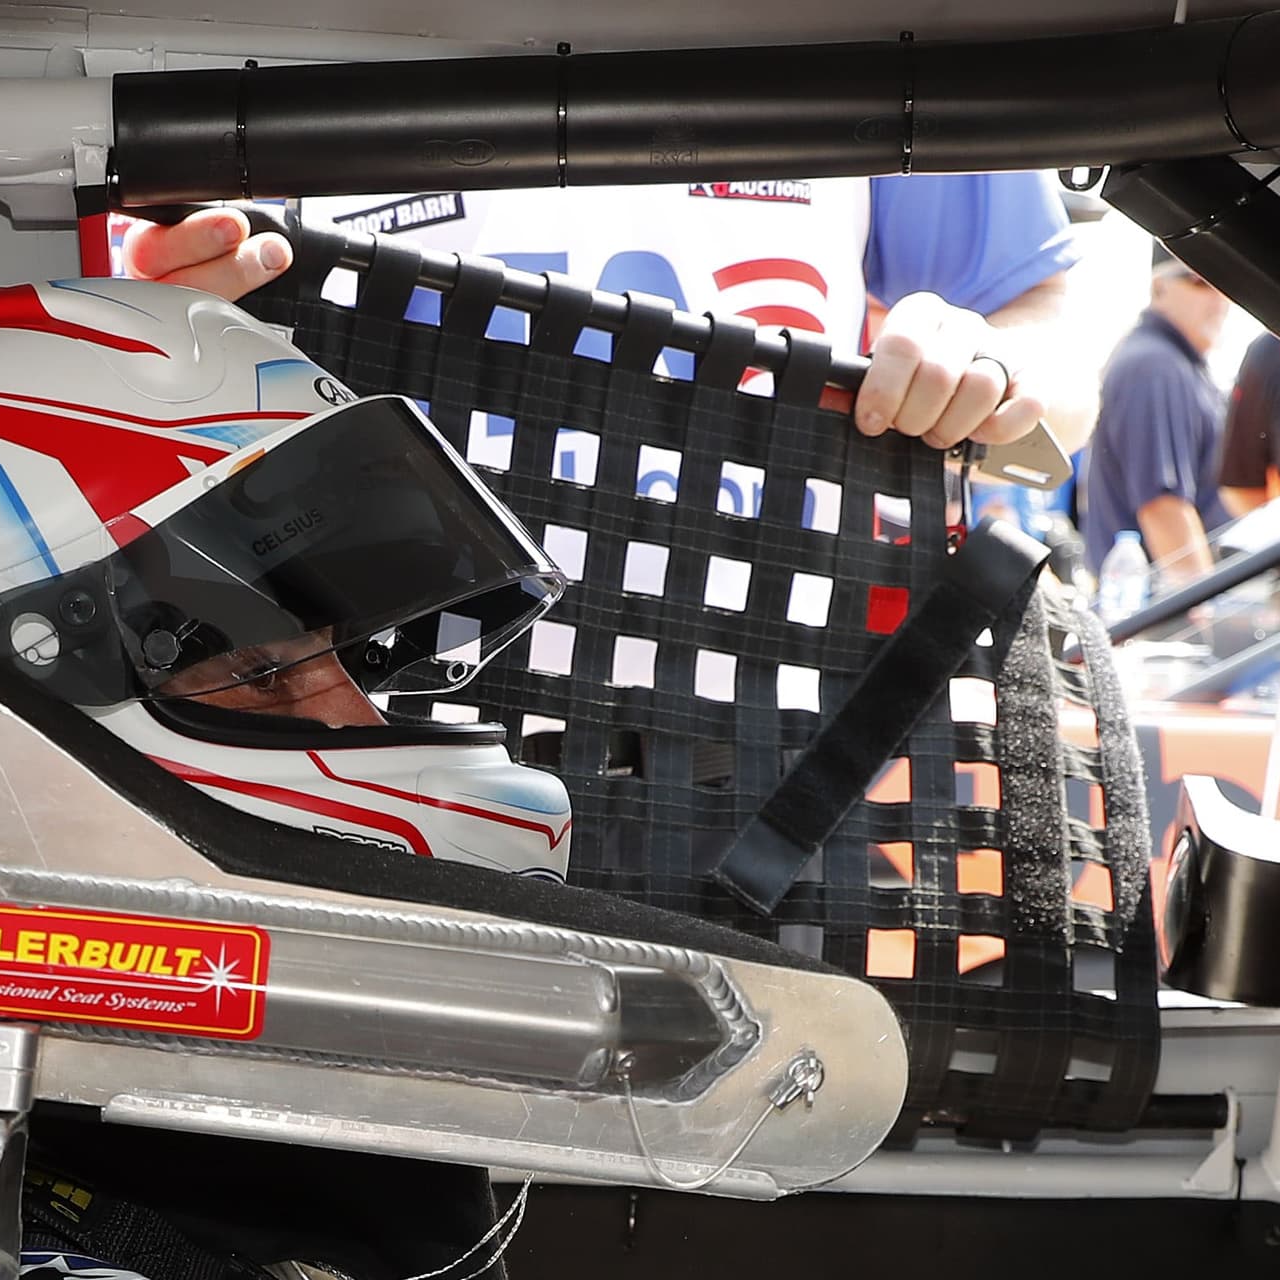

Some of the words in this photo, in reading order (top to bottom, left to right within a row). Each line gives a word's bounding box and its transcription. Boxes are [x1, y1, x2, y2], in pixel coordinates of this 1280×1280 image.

[396, 194, 457, 227] BARN
[252, 507, 324, 557] CELSIUS
[57, 988, 105, 1006] Seat
